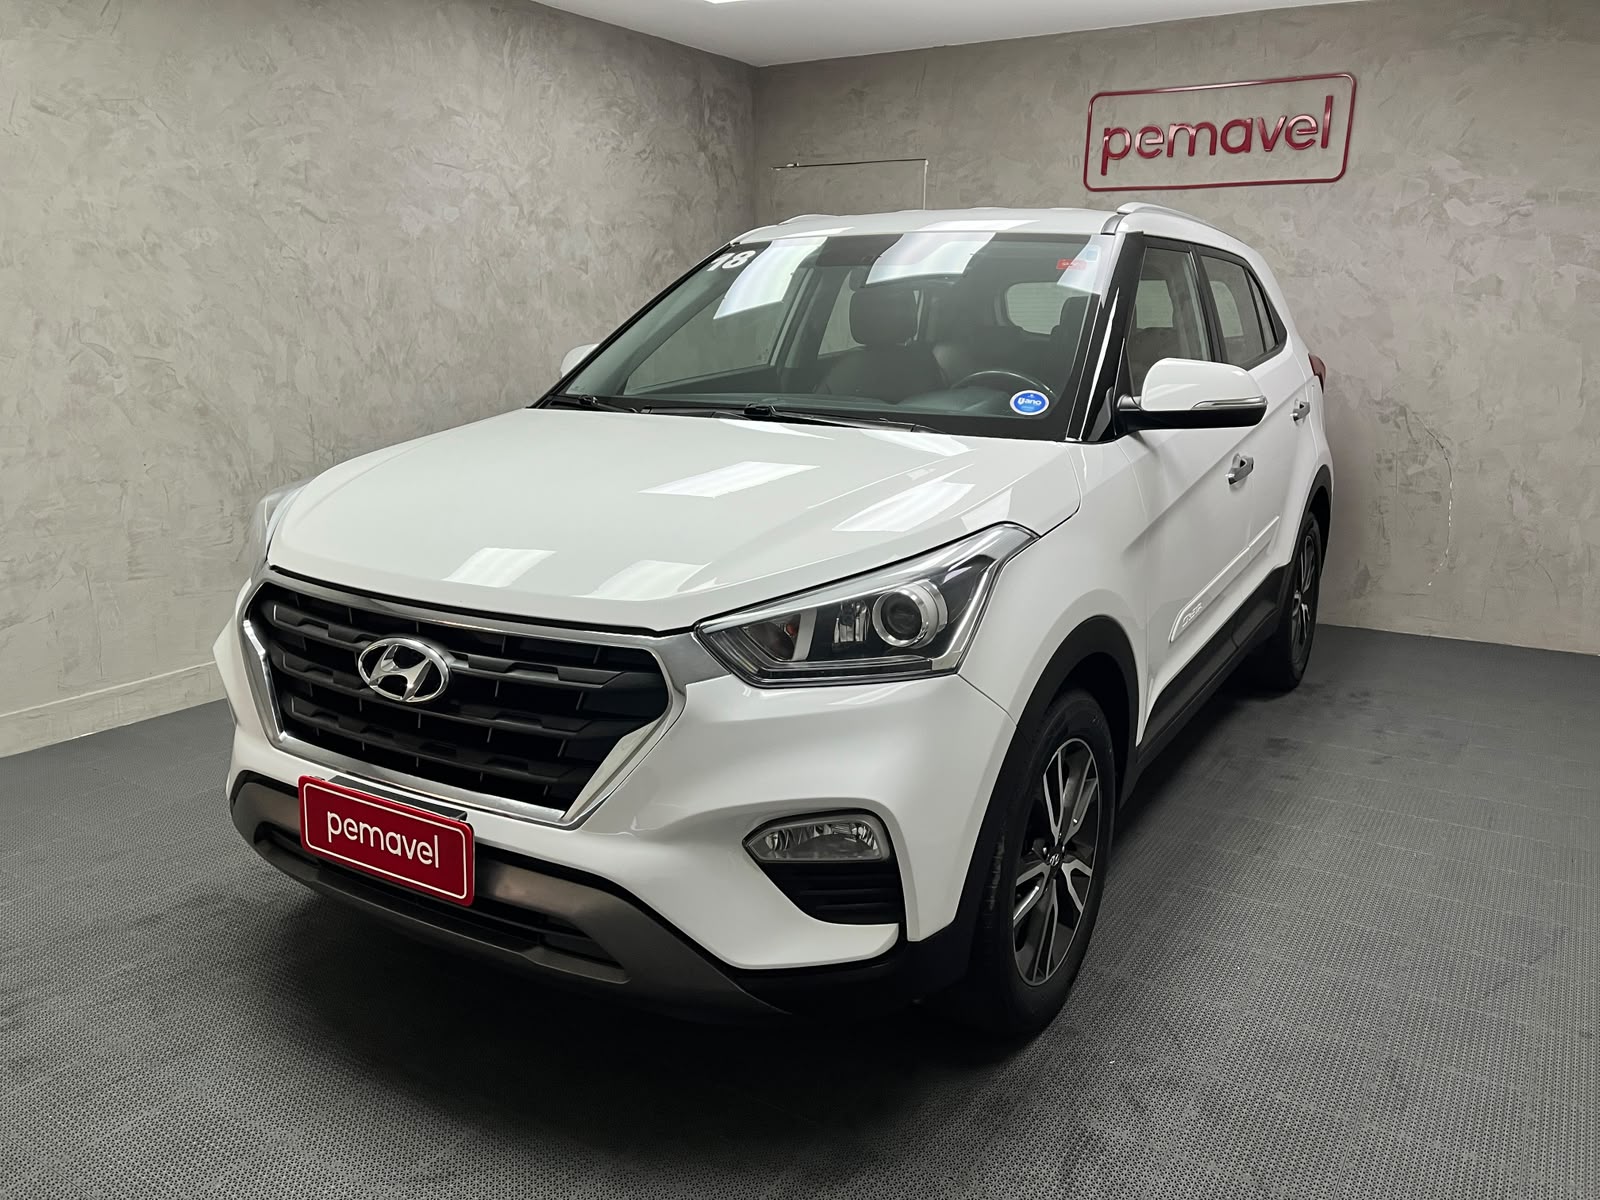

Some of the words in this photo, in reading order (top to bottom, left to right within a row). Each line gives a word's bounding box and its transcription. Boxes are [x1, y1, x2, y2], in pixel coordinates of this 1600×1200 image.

[1100, 95, 1334, 176] pemavel
[706, 250, 756, 271] 18
[327, 811, 439, 869] pemavel
